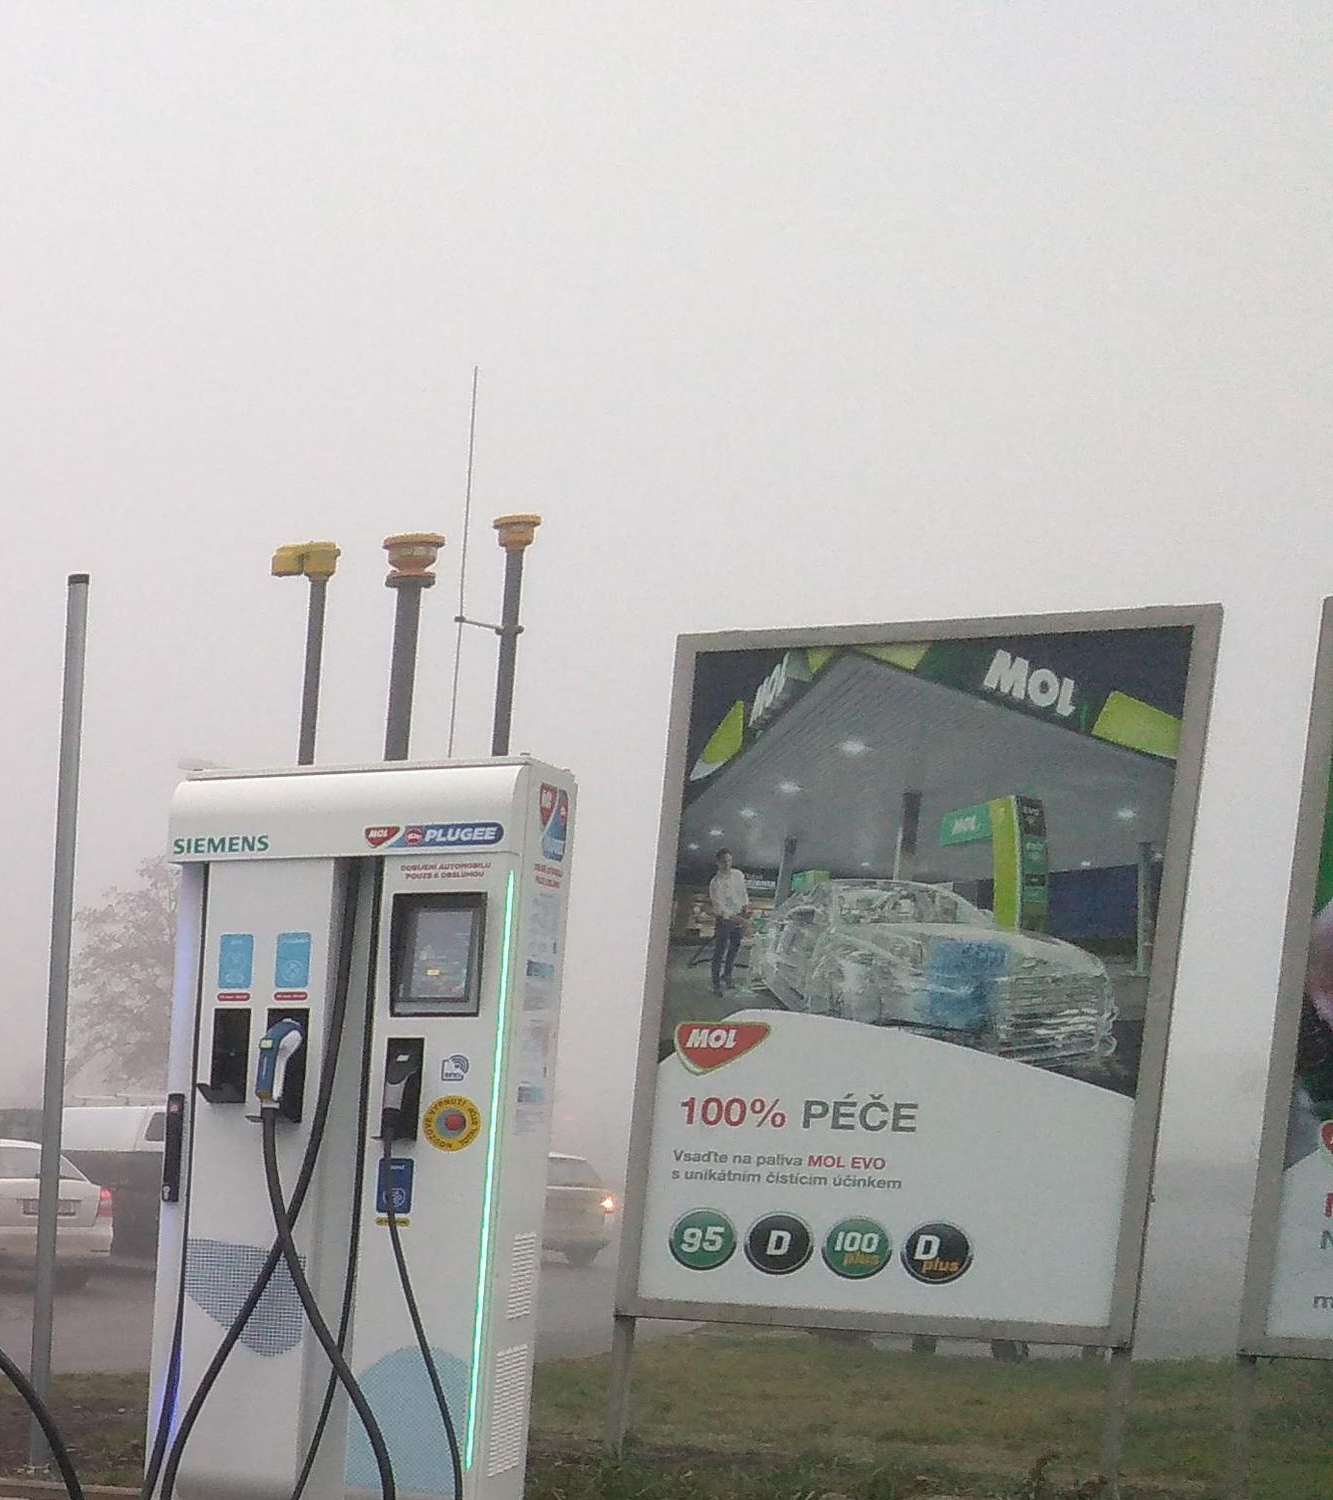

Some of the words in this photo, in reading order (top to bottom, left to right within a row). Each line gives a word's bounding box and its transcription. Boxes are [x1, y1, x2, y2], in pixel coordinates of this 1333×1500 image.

[983, 649, 1076, 717] MOL
[173, 835, 270, 855] SIEMENS
[424, 827, 498, 842] PLUGEE
[686, 1028, 737, 1049] MOL
[681, 1096, 787, 1128] 100%
[802, 1093, 919, 1132] PÉČE
[673, 1149, 728, 1164] Vsaďte
[733, 1153, 752, 1165] na
[756, 1152, 803, 1168] paliva
[807, 1155, 846, 1168] MOL
[850, 1156, 886, 1170] EVO
[671, 1170, 680, 1180] s
[684, 1167, 761, 1184] unikátním
[832, 1170, 902, 1189] účinkem
[681, 1225, 726, 1253] 95
[766, 1230, 791, 1256] D
[834, 1231, 880, 1254] 100
[914, 1234, 941, 1260] D
[921, 1258, 961, 1274] plus
